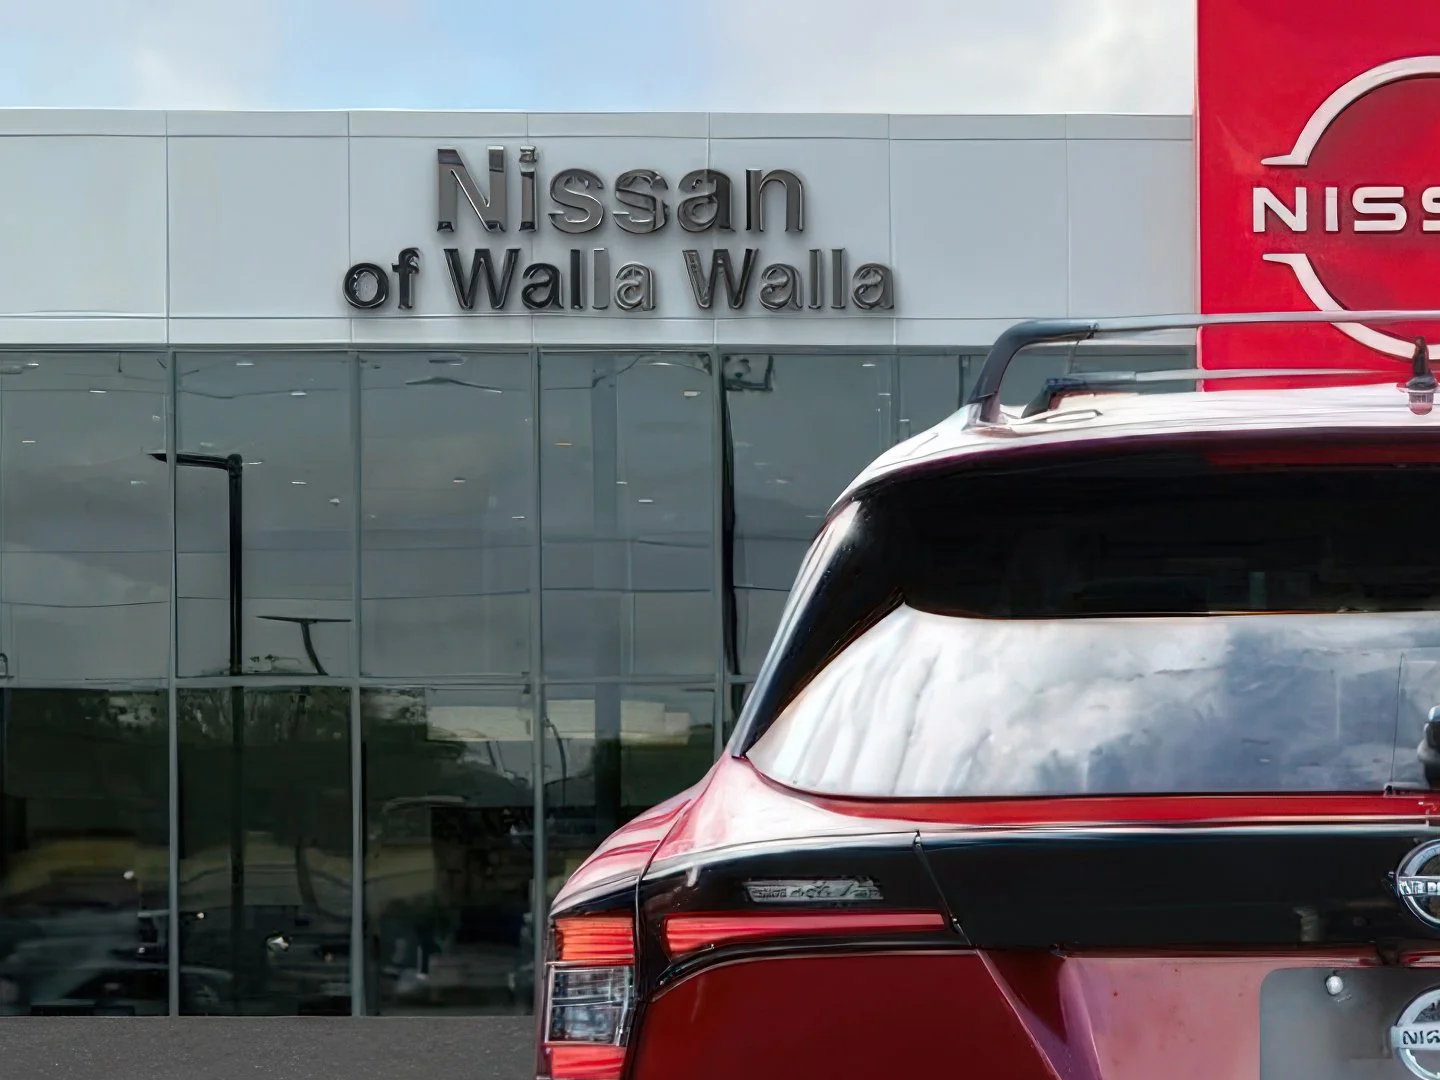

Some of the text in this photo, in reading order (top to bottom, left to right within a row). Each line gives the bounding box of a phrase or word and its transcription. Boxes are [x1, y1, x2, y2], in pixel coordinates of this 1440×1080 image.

[436, 145, 806, 234] Nissan
[343, 247, 896, 312] of Walla Walla
